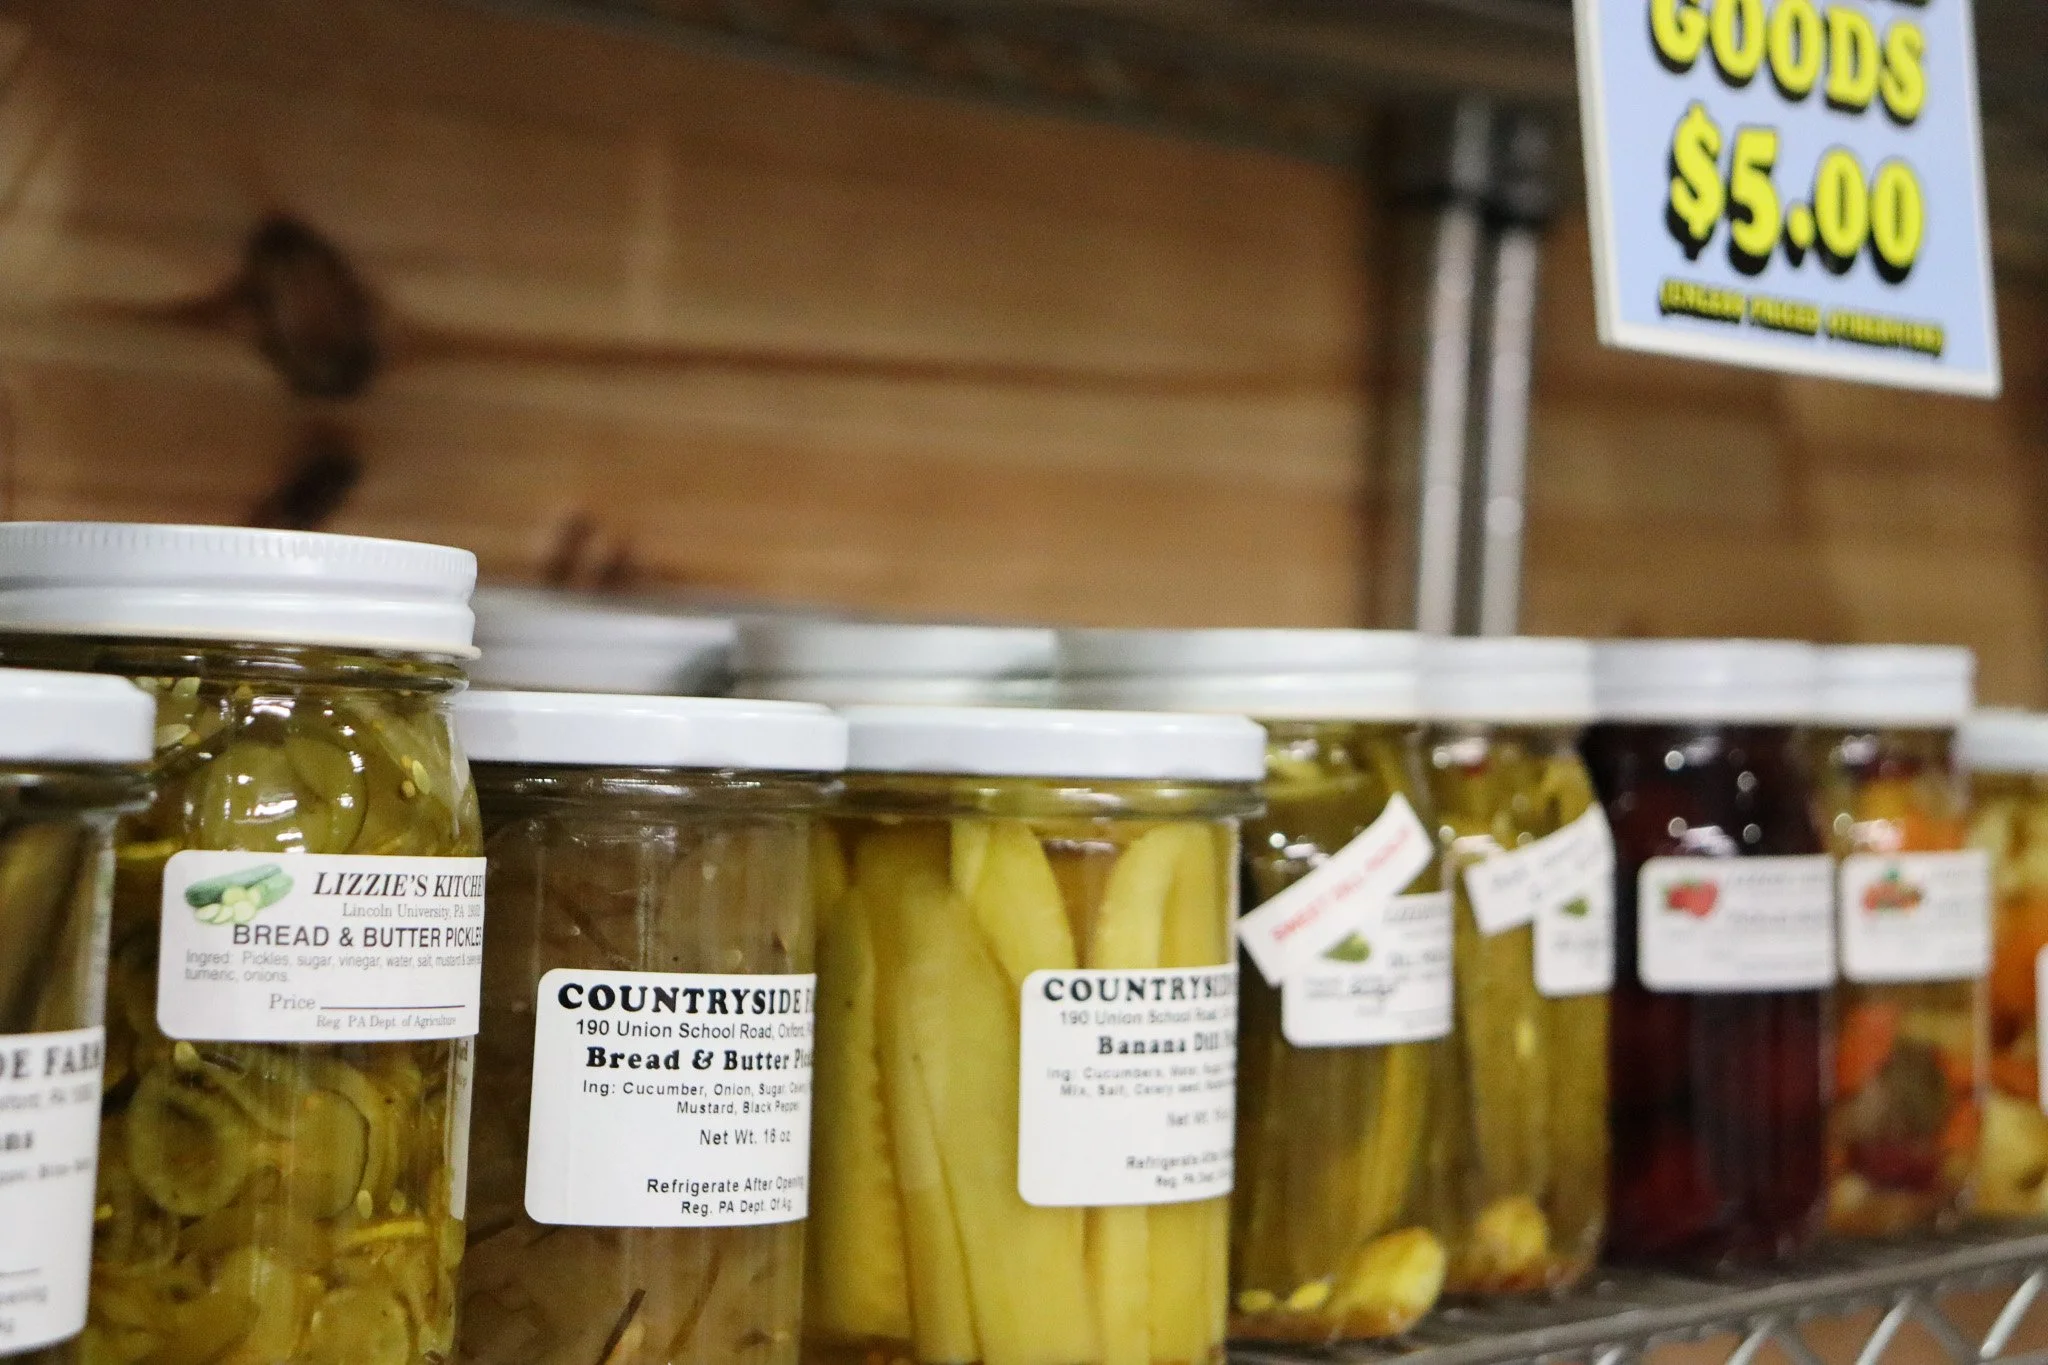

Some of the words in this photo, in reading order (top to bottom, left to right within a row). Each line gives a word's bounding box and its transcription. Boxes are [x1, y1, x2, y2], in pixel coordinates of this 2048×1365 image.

[1650, 0, 1926, 125] GOODS
[1666, 100, 1925, 284] $5.00
[312, 872, 428, 897] LIZZIE'S
[433, 874, 484, 897] KITCHE
[342, 902, 392, 917] Lincoln
[233, 923, 330, 946] BREAD
[339, 926, 353, 947] &
[363, 926, 441, 948] BUTTER
[269, 993, 316, 1010] Price
[557, 982, 802, 1015] COUNTRYSIDE
[1060, 1010, 1089, 1025] 190
[1094, 1009, 1142, 1024] Union
[576, 1019, 610, 1036] 190
[617, 1020, 672, 1038] Union
[678, 1022, 736, 1040] School
[740, 1023, 775, 1041] Road,
[1097, 1035, 1186, 1055] Banana
[586, 1046, 680, 1070] Bread
[692, 1049, 714, 1070] &
[723, 1049, 790, 1071] Butter
[583, 1080, 615, 1097] Ing:
[623, 1082, 708, 1098] Cucumber,
[714, 1083, 754, 1097] Onion,
[677, 1101, 738, 1115] Mustard,
[743, 1101, 772, 1114] Black
[699, 1129, 729, 1145] Net
[735, 1129, 757, 1145] Wt.
[779, 1130, 791, 1142] oz
[647, 1178, 739, 1197] Refrigerate
[744, 1177, 774, 1191] After
[681, 1200, 713, 1217] Reg.
[719, 1200, 735, 1214] PA
